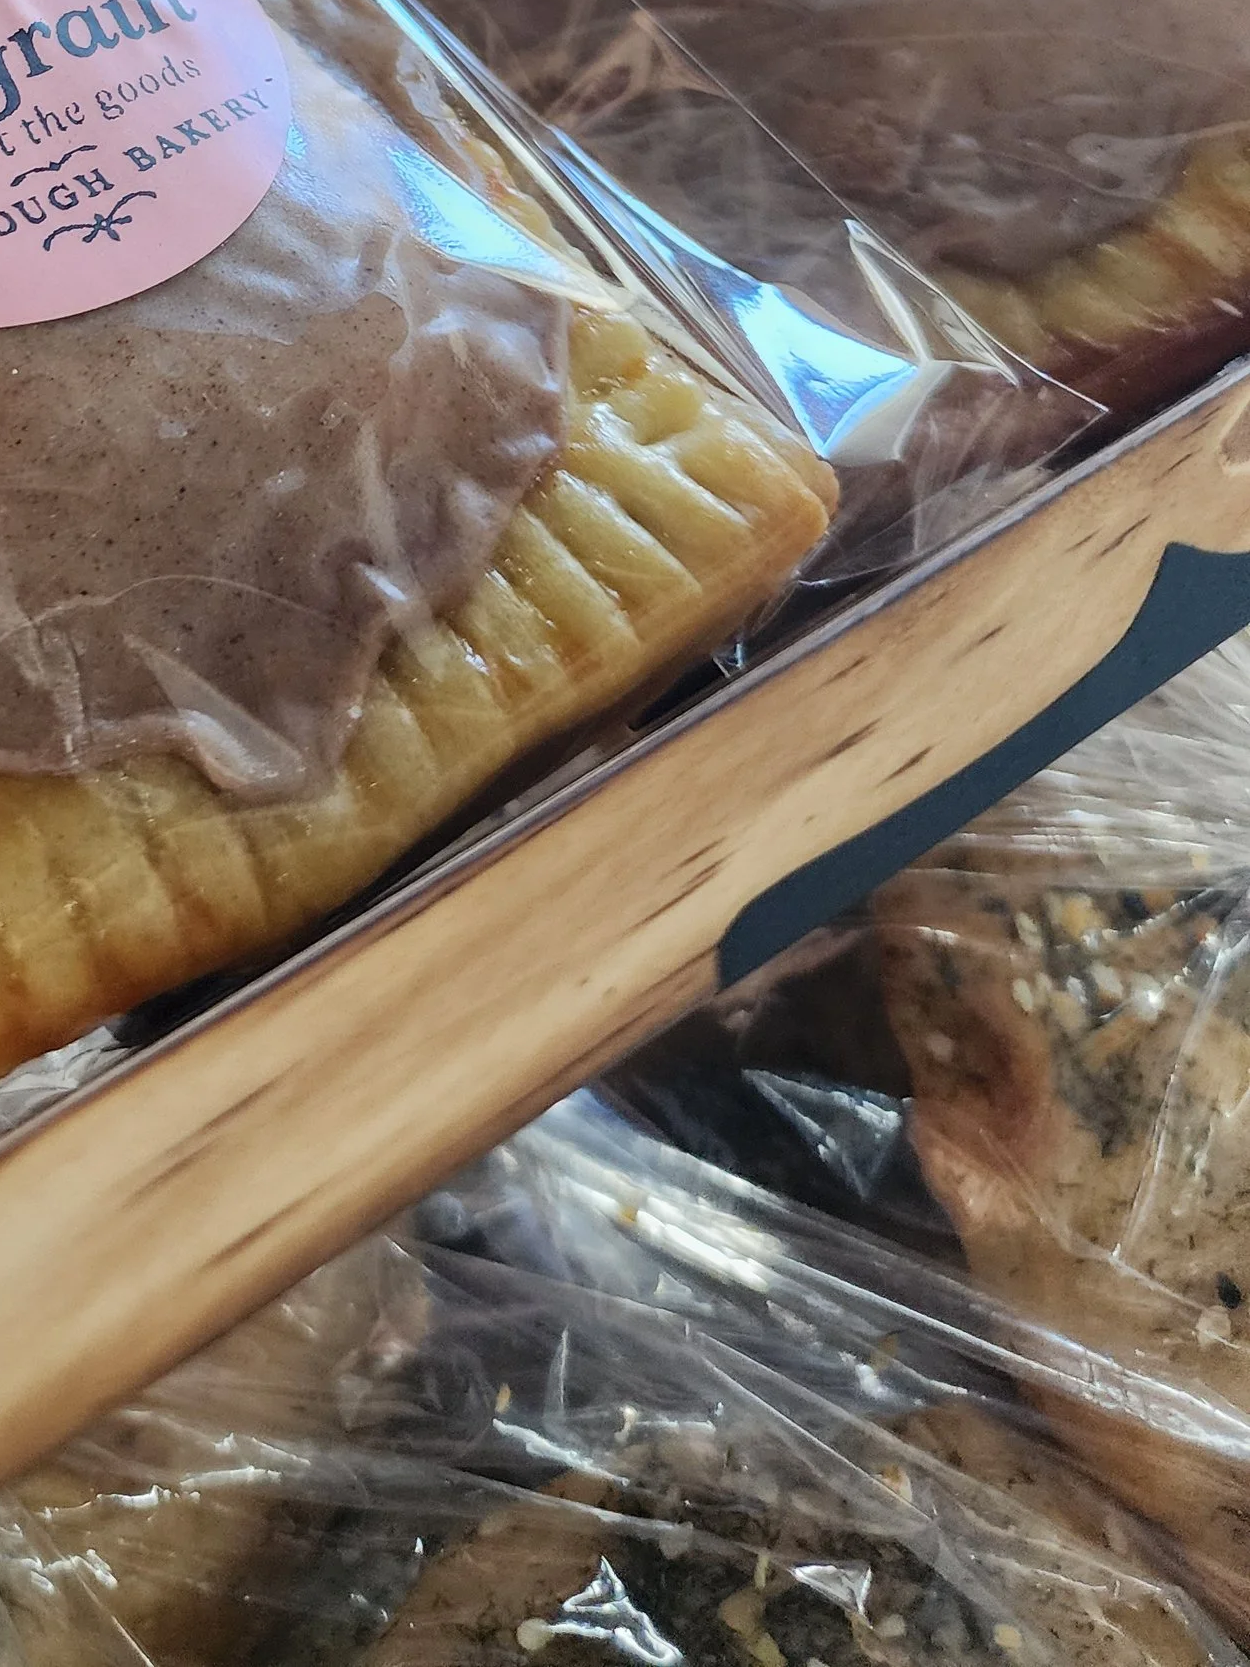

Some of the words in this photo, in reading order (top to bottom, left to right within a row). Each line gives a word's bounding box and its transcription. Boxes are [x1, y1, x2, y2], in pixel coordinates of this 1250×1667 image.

[20, 102, 87, 146] the
[94, 55, 202, 121] goods
[124, 87, 271, 172] BAKERY
